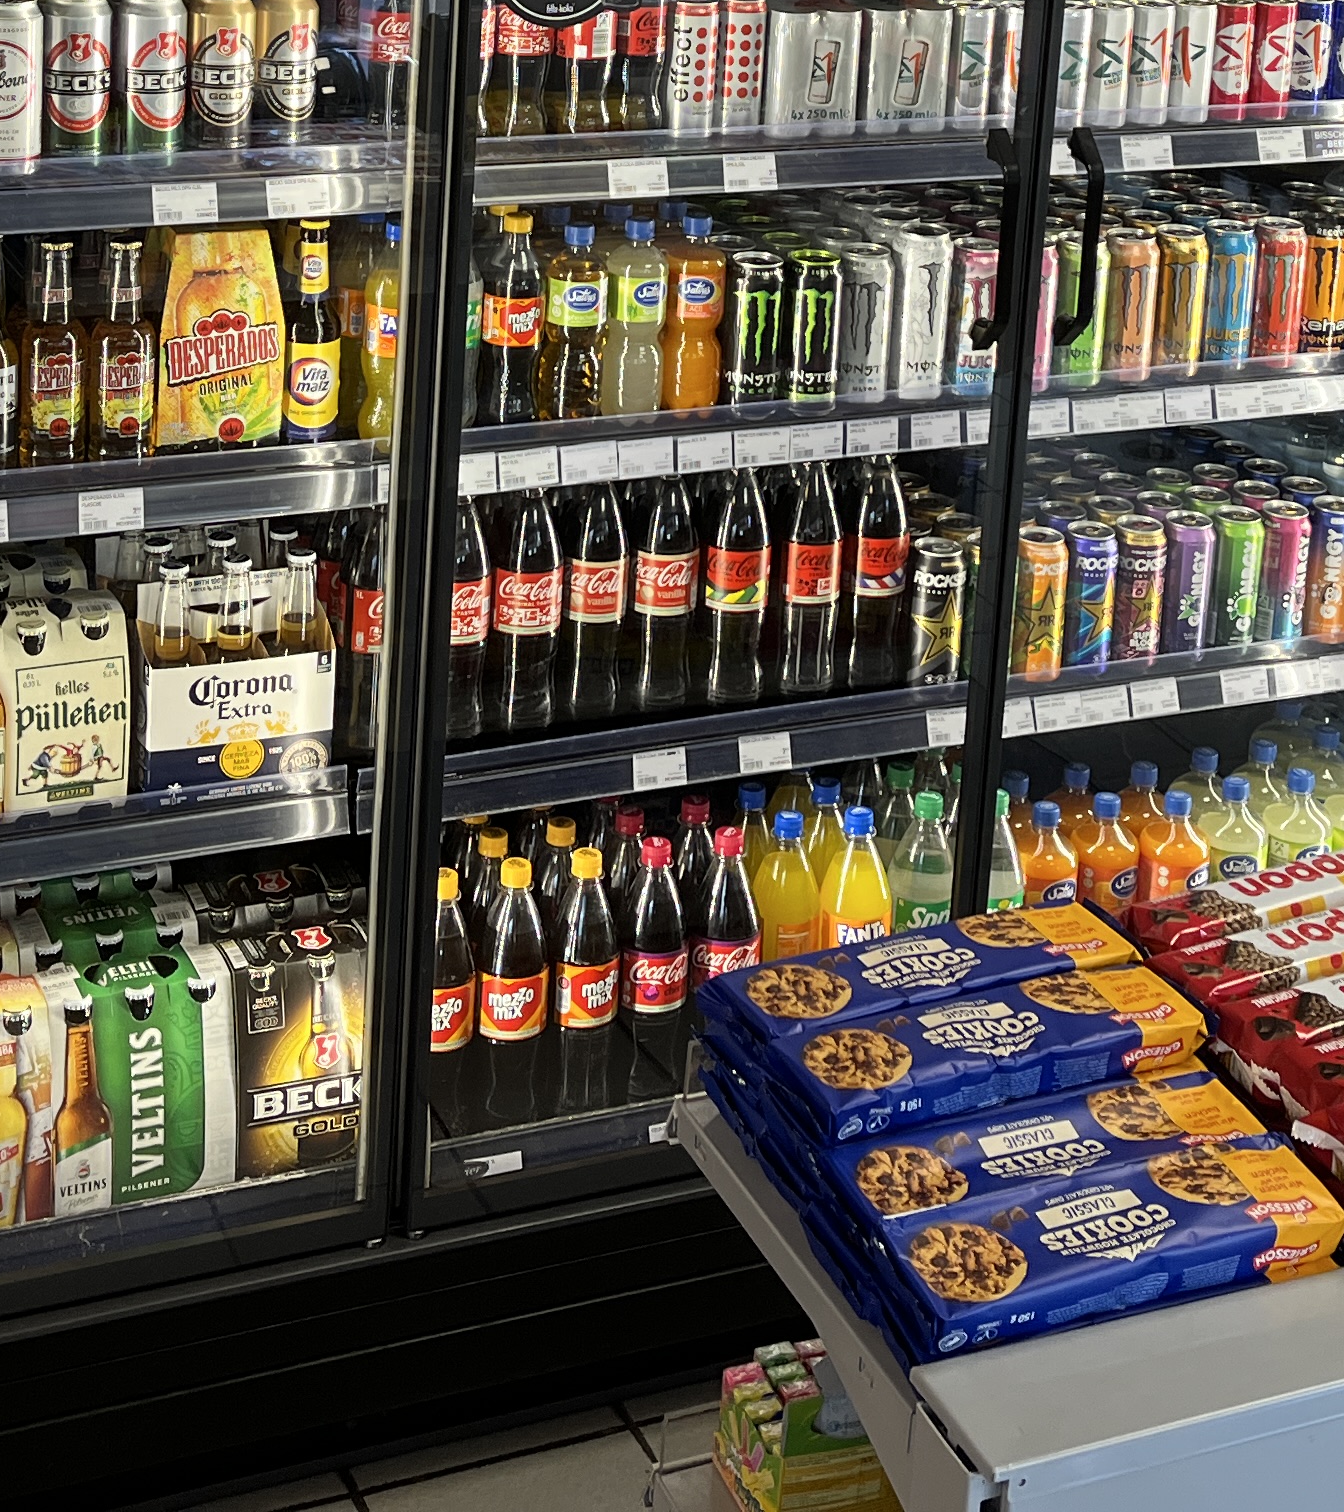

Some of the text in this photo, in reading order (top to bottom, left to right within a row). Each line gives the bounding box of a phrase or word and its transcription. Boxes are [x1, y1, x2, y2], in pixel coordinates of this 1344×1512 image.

[674, 25, 694, 104] effect
[45, 74, 111, 92] BECK'S
[209, 91, 243, 100] GOLD
[508, 309, 542, 325] mezzo
[512, 319, 535, 334] mix
[170, 332, 279, 382] DESPERADOS
[198, 372, 254, 396] ORIGINAL
[300, 367, 328, 382] Vita
[220, 391, 238, 402] BIER
[295, 378, 330, 395] malz
[656, 589, 687, 600] vanilla
[321, 654, 328, 665] 6
[55, 679, 90, 697] helles
[188, 672, 293, 708] Corona
[16, 696, 128, 738] Pülleken
[217, 702, 273, 721] Extra
[224, 751, 260, 760] CERVEZA
[62, 905, 140, 927] VELTINS
[879, 939, 930, 958] CLASSIC
[861, 947, 976, 984] COOKIES
[581, 969, 619, 997] mezzo
[488, 988, 535, 1010] mezzo
[587, 987, 613, 1009] mix
[493, 1002, 523, 1020] mix
[939, 1004, 991, 1021] CLASSIC
[922, 1011, 1040, 1046] COOKIES
[1124, 1040, 1182, 1067] GRIESSON
[129, 1027, 165, 1177] VELTINS
[292, 1114, 360, 1139] GOLD
[1001, 1128, 1058, 1150] CLASSIC
[980, 1138, 1107, 1178] COOKIES
[59, 1178, 107, 1197] VELTINS
[121, 1177, 171, 1193] PILSENER
[1062, 1195, 1117, 1221] CLASSIC
[1245, 1199, 1313, 1221] GRIESSON
[1039, 1204, 1171, 1251] COOKIES
[1254, 1243, 1320, 1268] GRIESSON
[1018, 1311, 1036, 1325] 150
